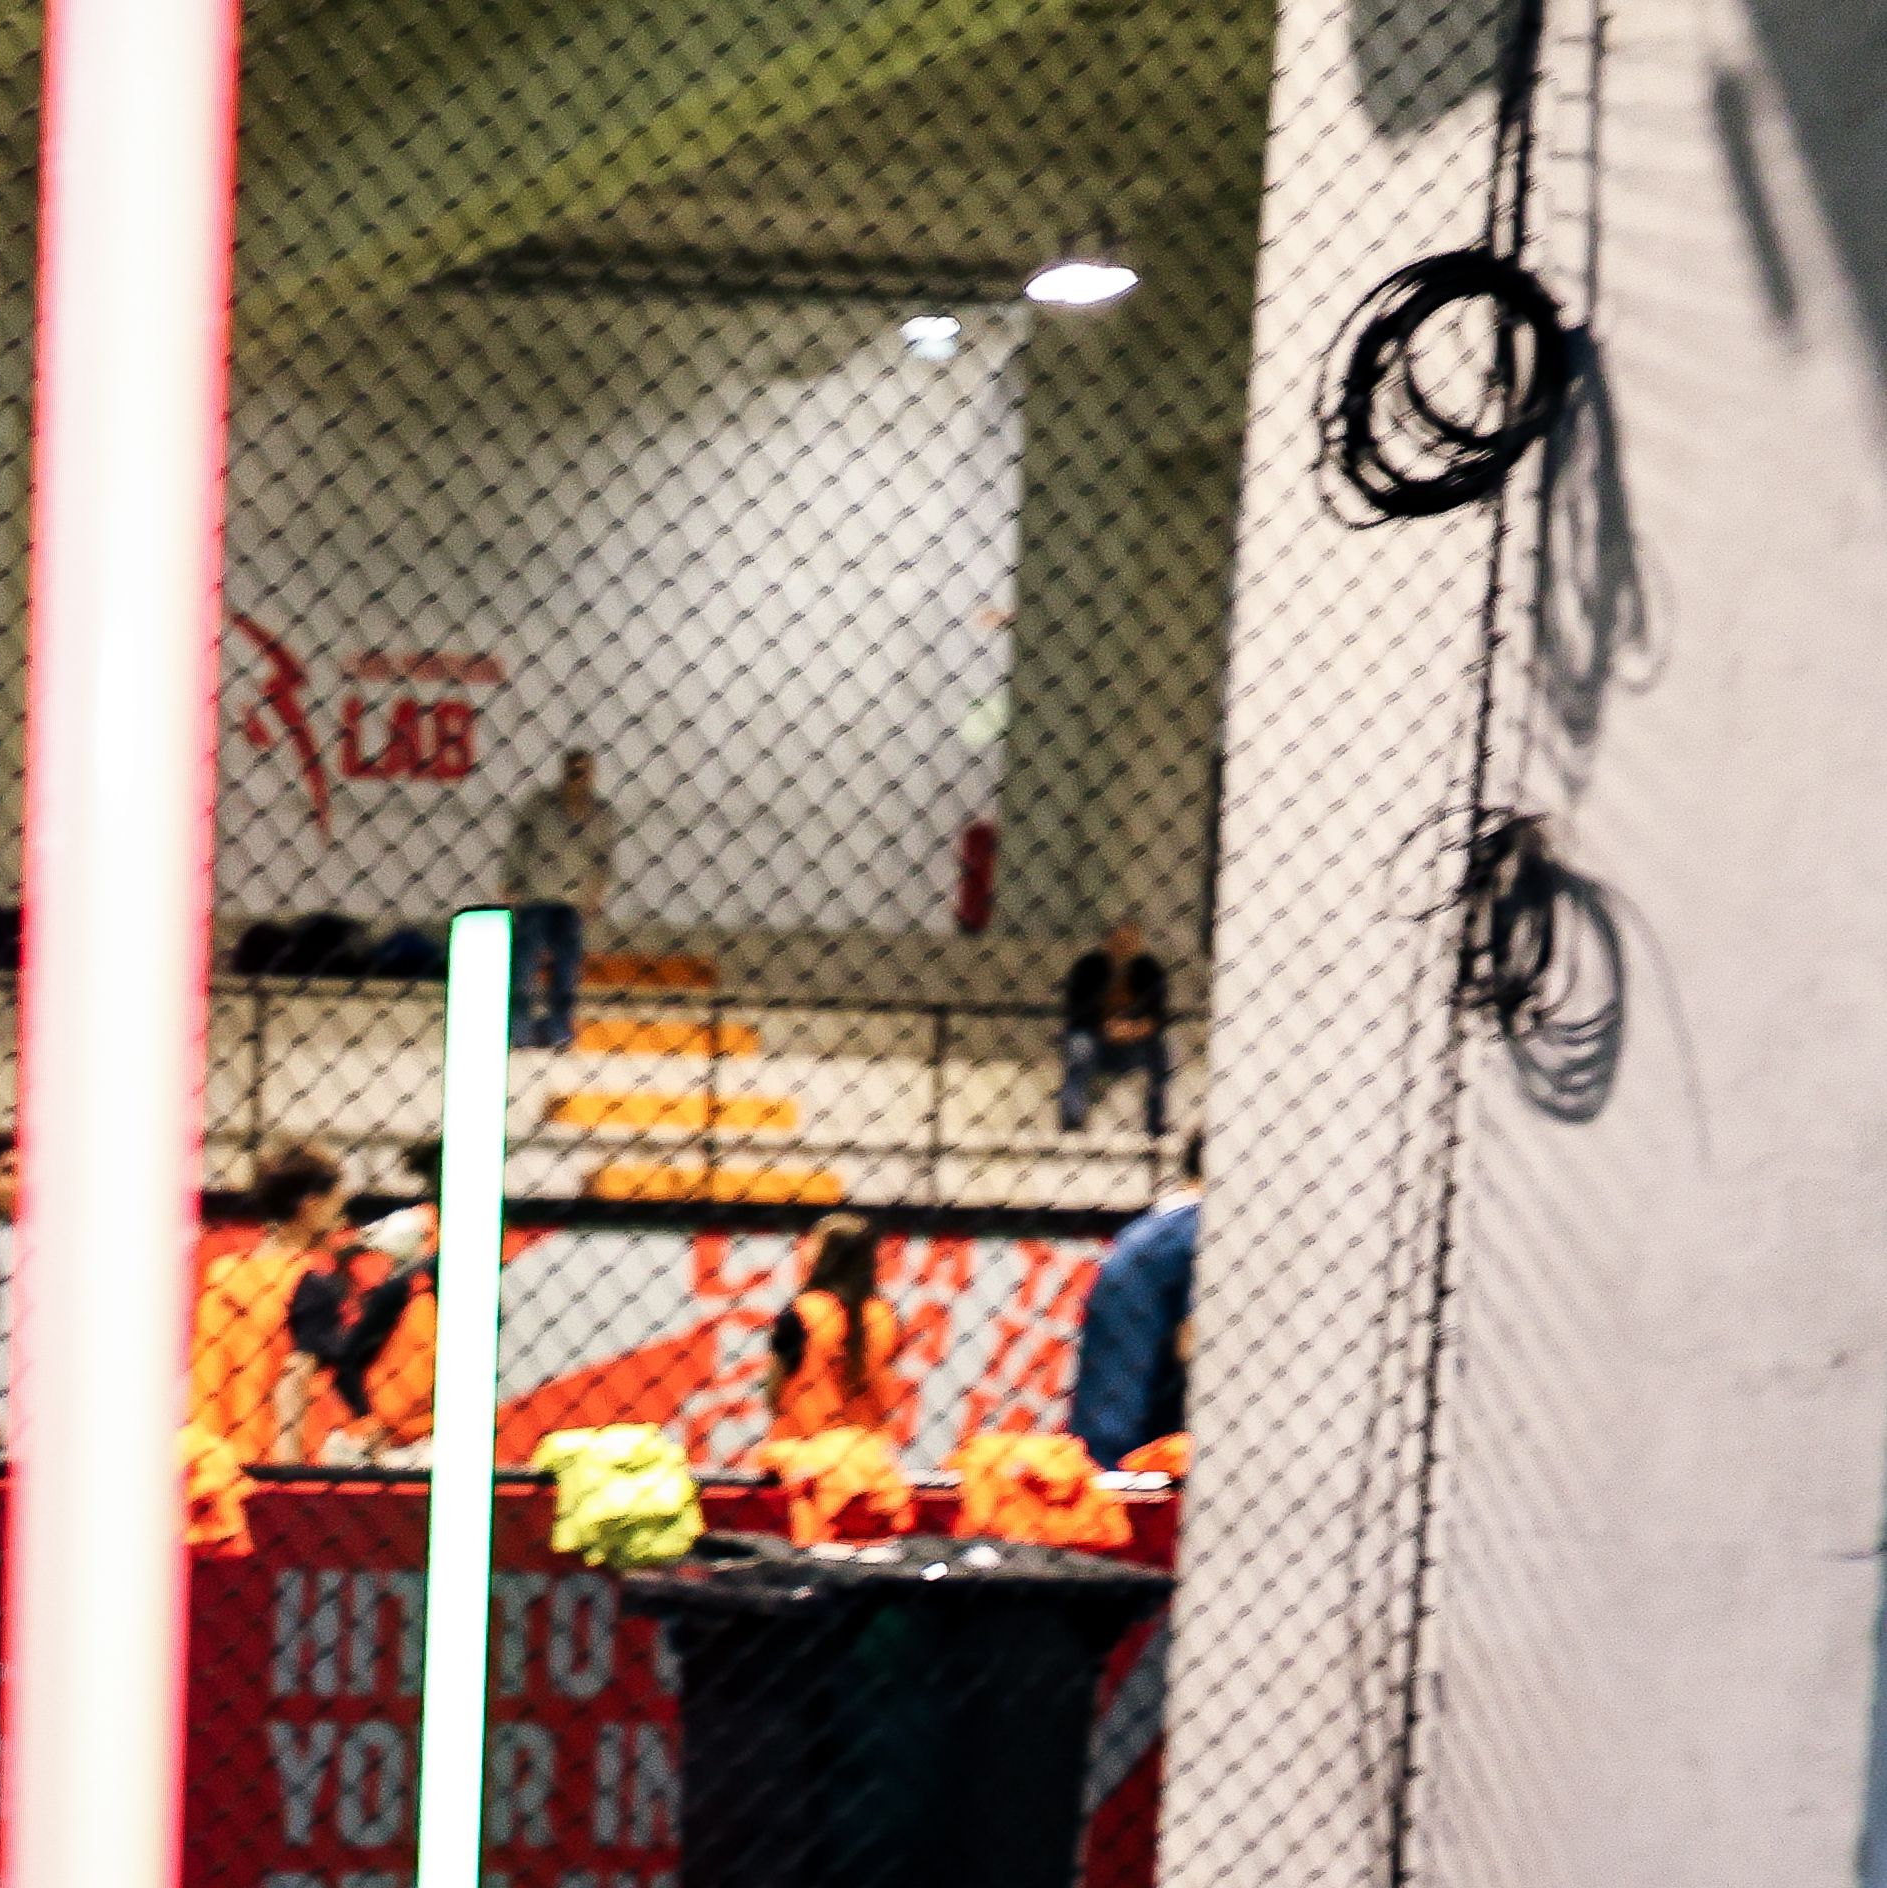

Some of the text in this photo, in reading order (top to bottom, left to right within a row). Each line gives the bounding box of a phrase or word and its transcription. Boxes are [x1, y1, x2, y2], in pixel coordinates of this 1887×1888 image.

[337, 695, 478, 784] LAB
[271, 1568, 429, 1697] HIT
[489, 1570, 621, 1698] TO
[265, 1720, 557, 1848] YOR
